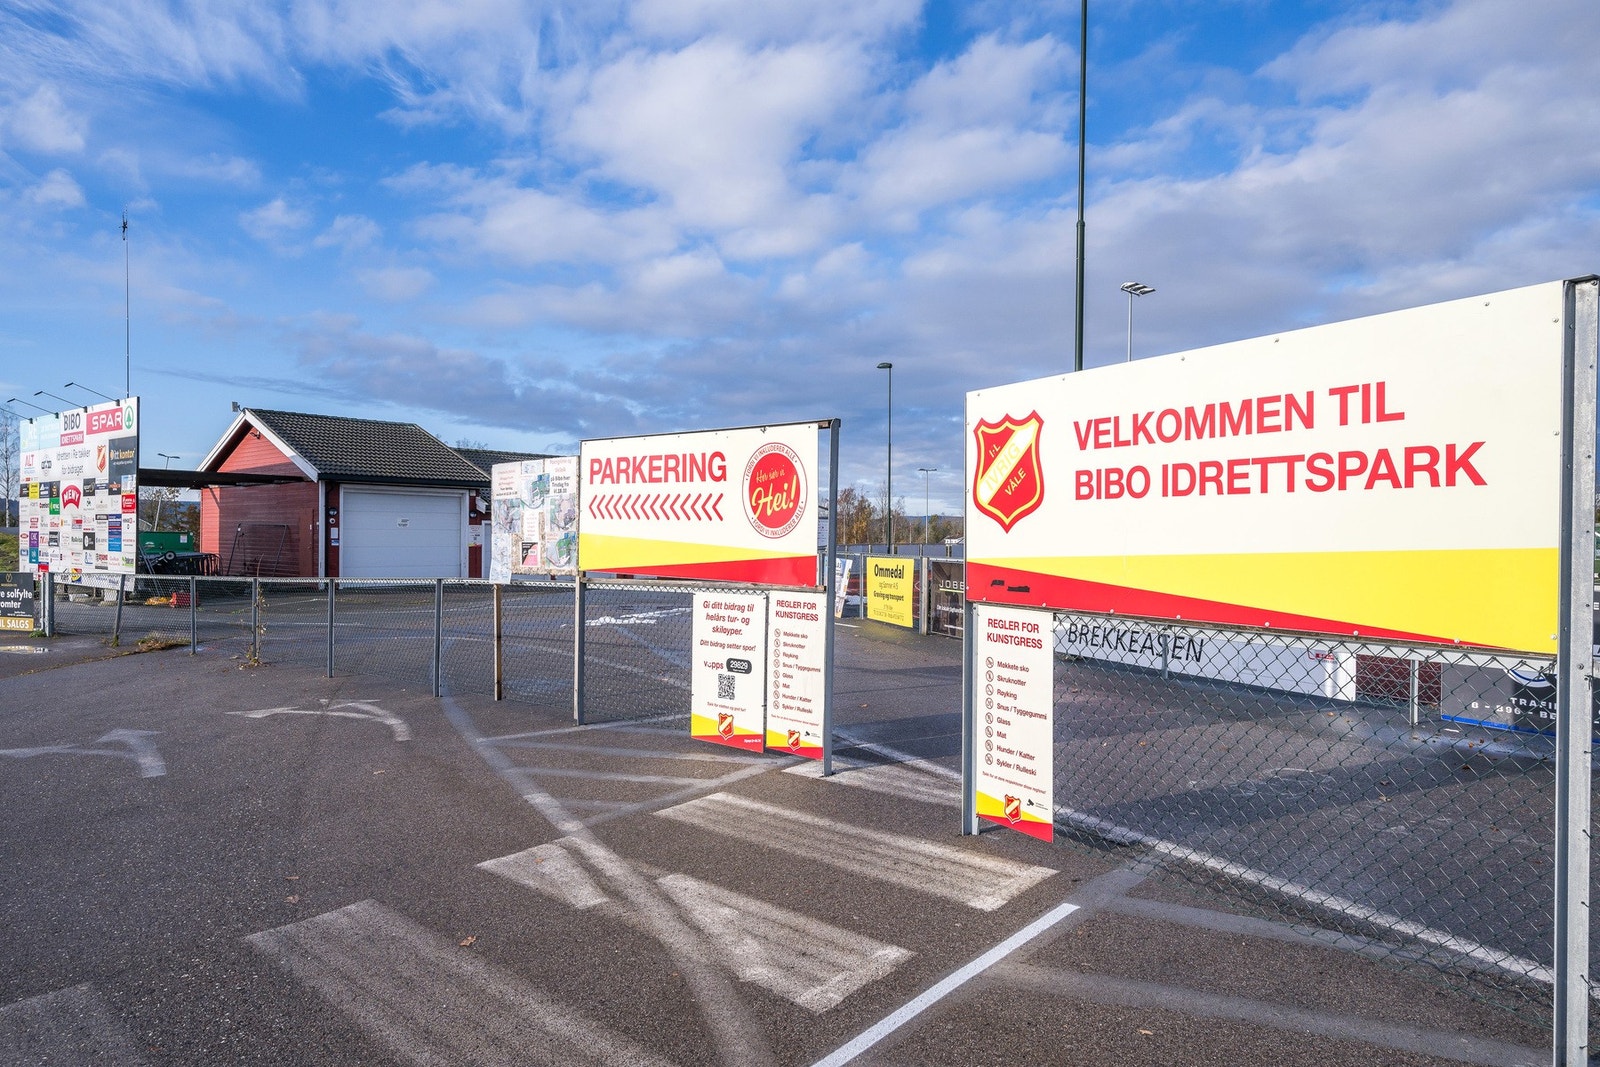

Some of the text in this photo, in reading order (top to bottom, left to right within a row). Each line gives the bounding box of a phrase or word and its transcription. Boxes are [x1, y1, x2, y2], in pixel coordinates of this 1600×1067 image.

[64, 413, 80, 431] BIBO
[92, 412, 122, 431] SPAR
[1073, 380, 1405, 451] VELKOMMEN TIL
[590, 451, 727, 485] PARKERING
[1075, 441, 1488, 500] BIBO IDRETTSPARK
[64, 489, 80, 502] MENY
[752, 474, 797, 519] Hei!
[874, 564, 904, 579] Ommedal
[7, 589, 32, 601] solfylte
[703, 600, 710, 608] Gi
[724, 602, 745, 613] bidrag
[776, 600, 817, 610] REGLER FOR
[706, 613, 750, 626] helårs tur- og
[776, 610, 819, 622] KUNSTGRESS
[7, 620, 29, 628] SALGS
[988, 618, 1039, 633] REGLER FOR
[710, 640, 726, 649] bidrag
[987, 633, 1043, 649] KUNSTGRESS
[997, 675, 1026, 687] Skruknotter
[997, 688, 1017, 700] Røyking
[997, 702, 1009, 712] Snus
[1013, 706, 1047, 720] Tyggegummi
[996, 717, 1011, 726] Glass
[996, 731, 1007, 739] Mat
[996, 744, 1015, 756] Hunder
[1019, 750, 1035, 761] Katter
[996, 759, 1012, 768] Sykler
[1016, 764, 1037, 776] Rulleski
